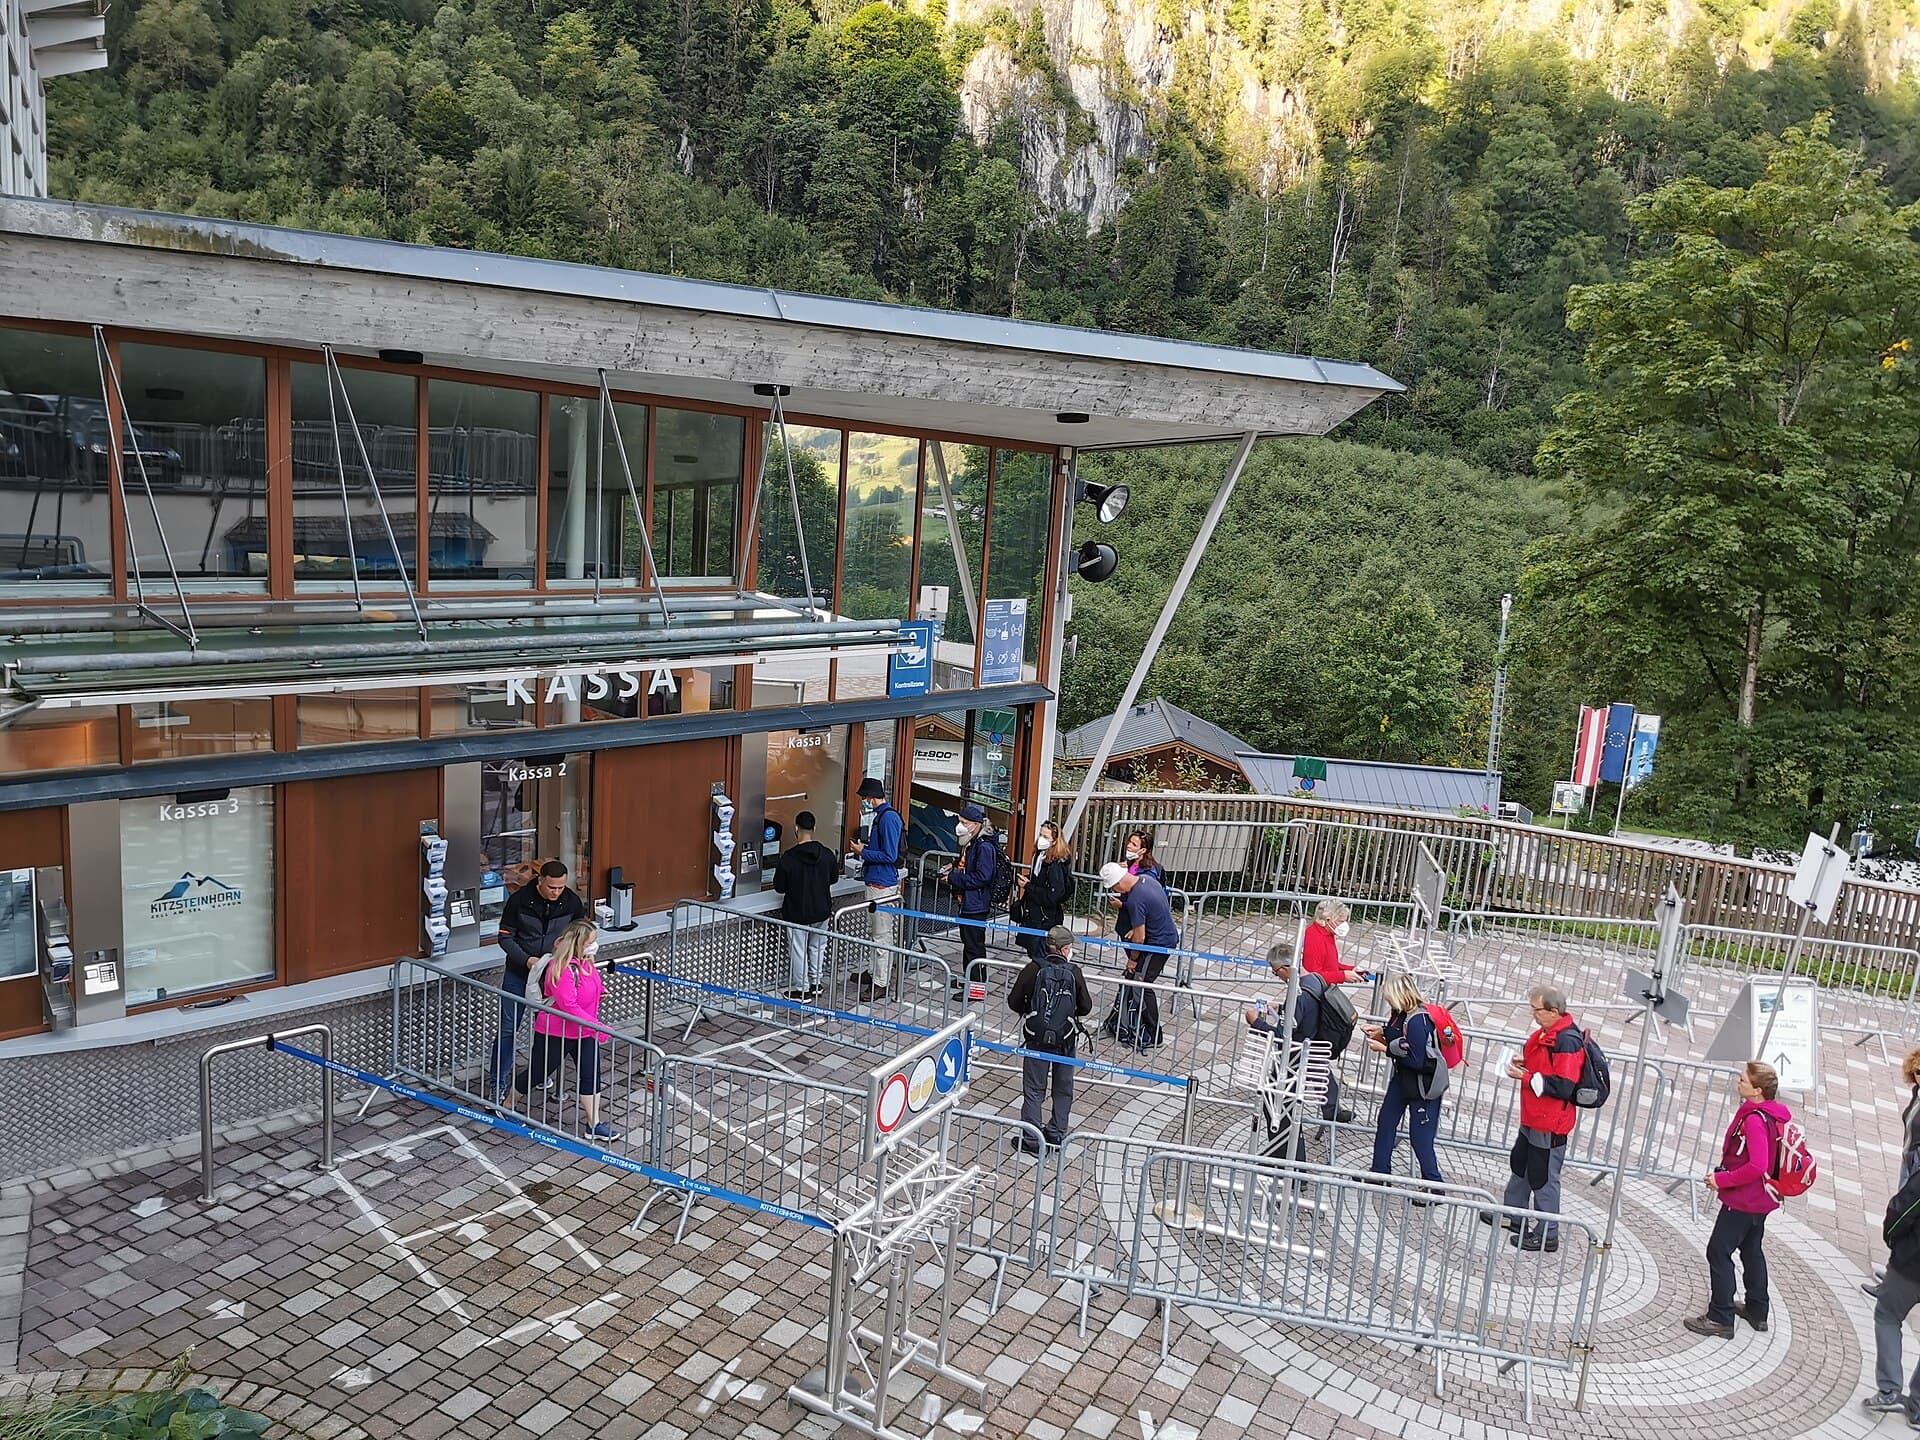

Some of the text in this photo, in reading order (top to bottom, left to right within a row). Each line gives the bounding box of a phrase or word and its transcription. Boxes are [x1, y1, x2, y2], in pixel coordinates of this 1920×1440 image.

[506, 661, 678, 706] KASSA
[788, 732, 832, 749] Kassa 1
[508, 762, 567, 782] Kassa 2
[159, 798, 240, 821] Kassa 3
[150, 890, 241, 914] KITZSTEINHORN
